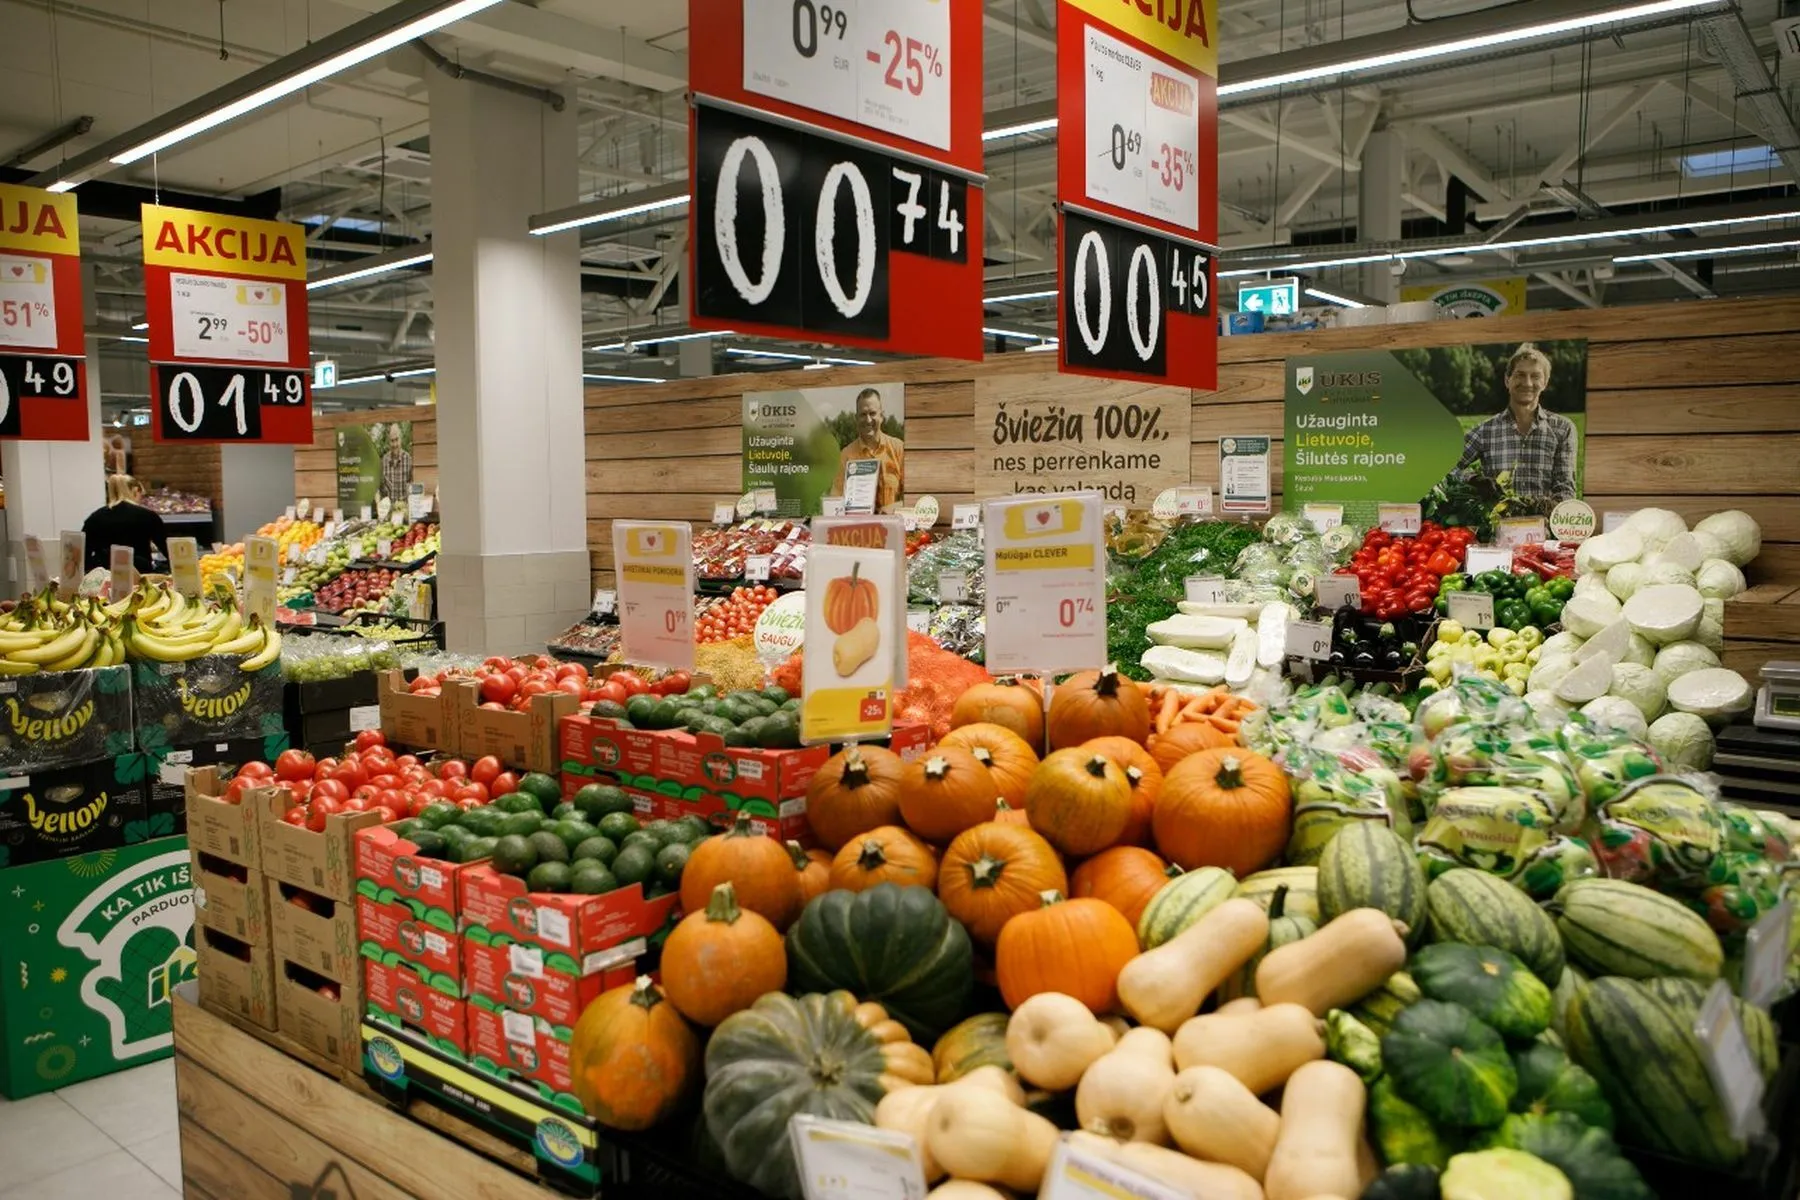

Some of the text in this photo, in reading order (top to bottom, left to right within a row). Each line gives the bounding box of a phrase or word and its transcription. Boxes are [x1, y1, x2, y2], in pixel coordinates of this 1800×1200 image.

[155, 220, 297, 267] AKCIJA
[1296, 413, 1378, 429] Užauginta
[748, 435, 794, 448] Užauginta
[1295, 432, 1374, 448] Lietuvoje,
[993, 450, 1161, 474] nes perrenkame
[1295, 449, 1406, 467] Šilutės rajone
[780, 462, 809, 475] rajone
[1033, 548, 1068, 558] CLEVER
[760, 632, 796, 647] SAUGU
[132, 875, 166, 898] TIK
[172, 866, 194, 886] IŠ
